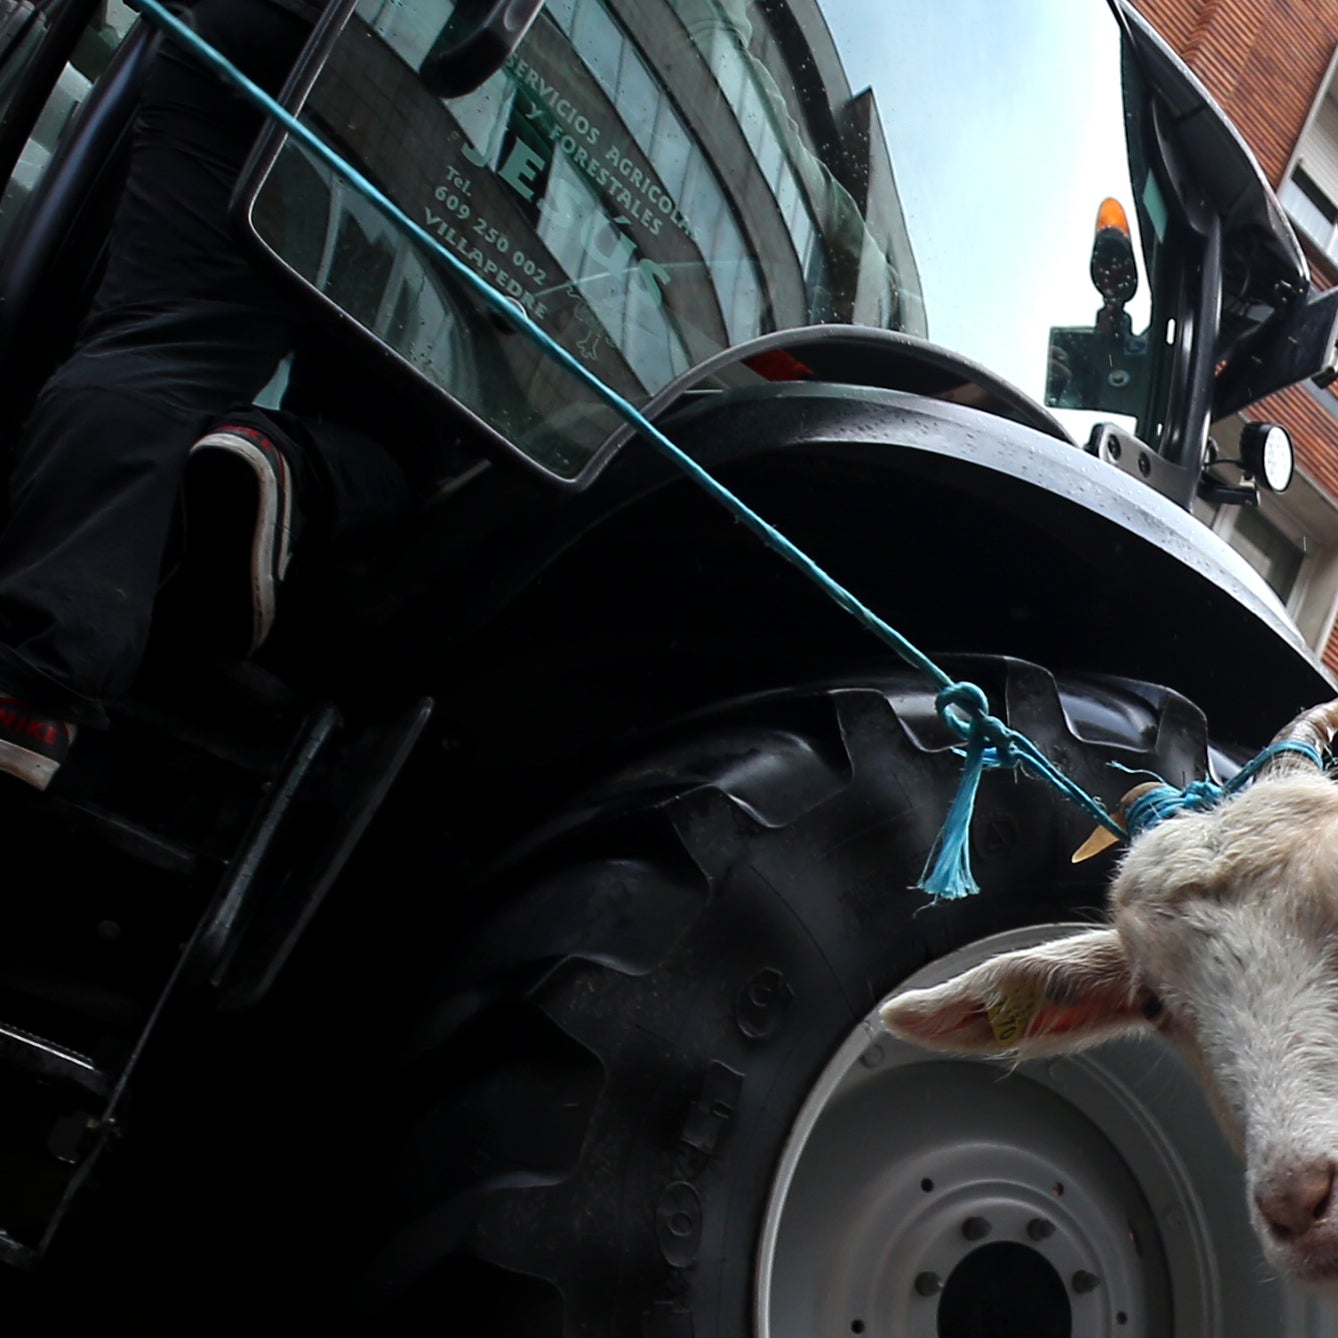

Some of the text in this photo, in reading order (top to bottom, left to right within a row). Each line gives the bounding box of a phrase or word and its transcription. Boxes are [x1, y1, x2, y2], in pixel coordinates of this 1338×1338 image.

[446, 165, 472, 198] Tel.
[505, 52, 693, 236] SERVICIOS AGRICOLA
[549, 123, 664, 236] FORESTALES
[424, 205, 548, 321] VILLAPEDRE
[434, 185, 547, 286] 609 250 002
